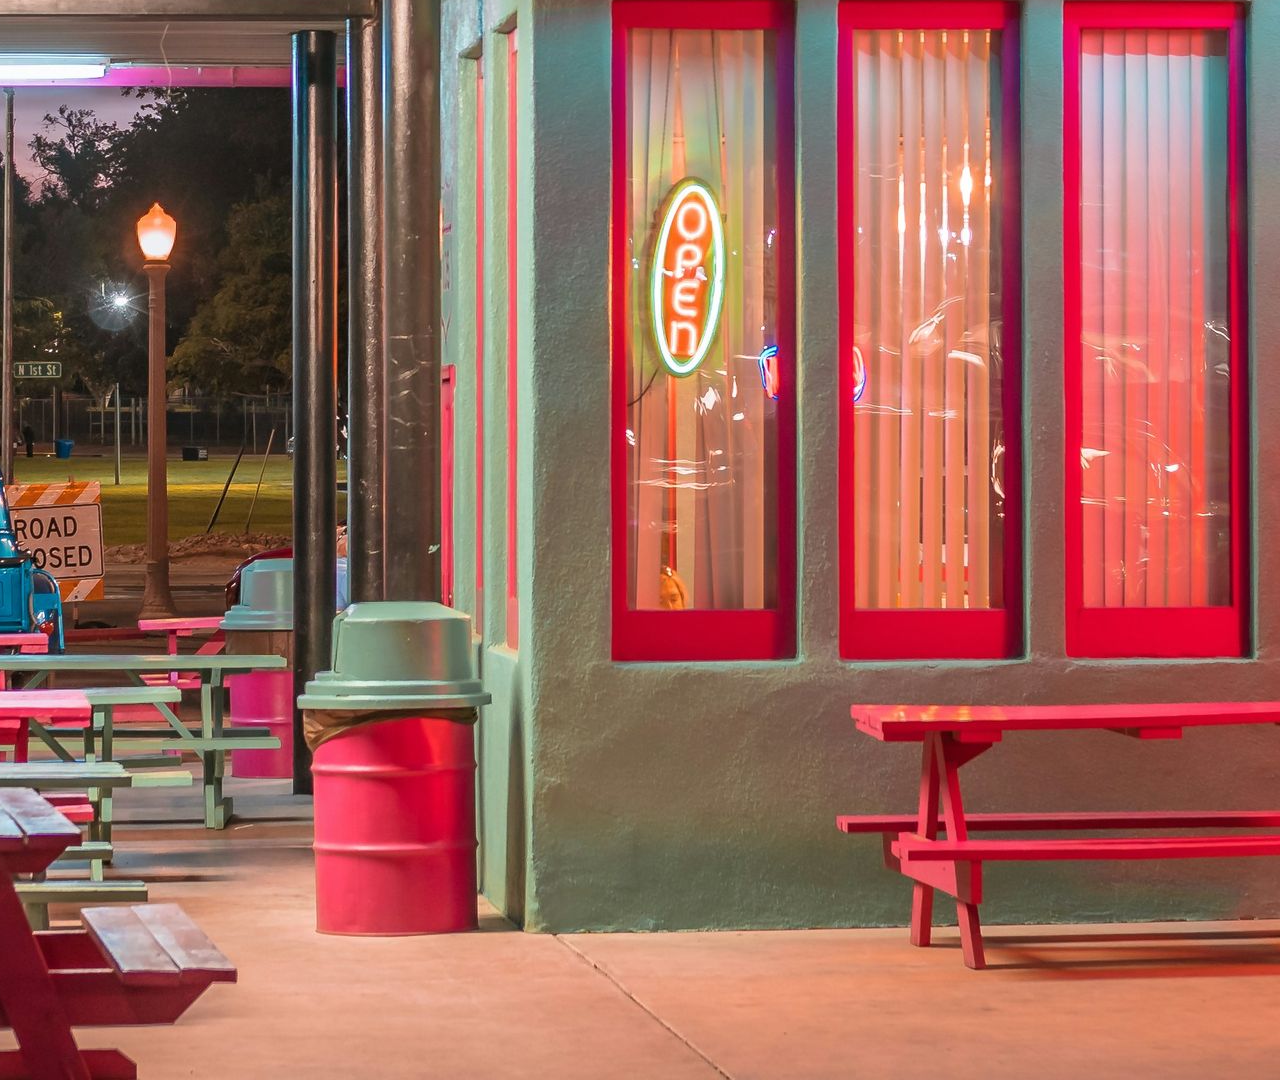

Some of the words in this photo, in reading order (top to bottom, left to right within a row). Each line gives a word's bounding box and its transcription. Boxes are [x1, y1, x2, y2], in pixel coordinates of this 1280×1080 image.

[18, 364, 25, 376] N
[29, 364, 42, 376] 1st
[46, 364, 57, 376] St
[14, 515, 78, 540] ROAD
